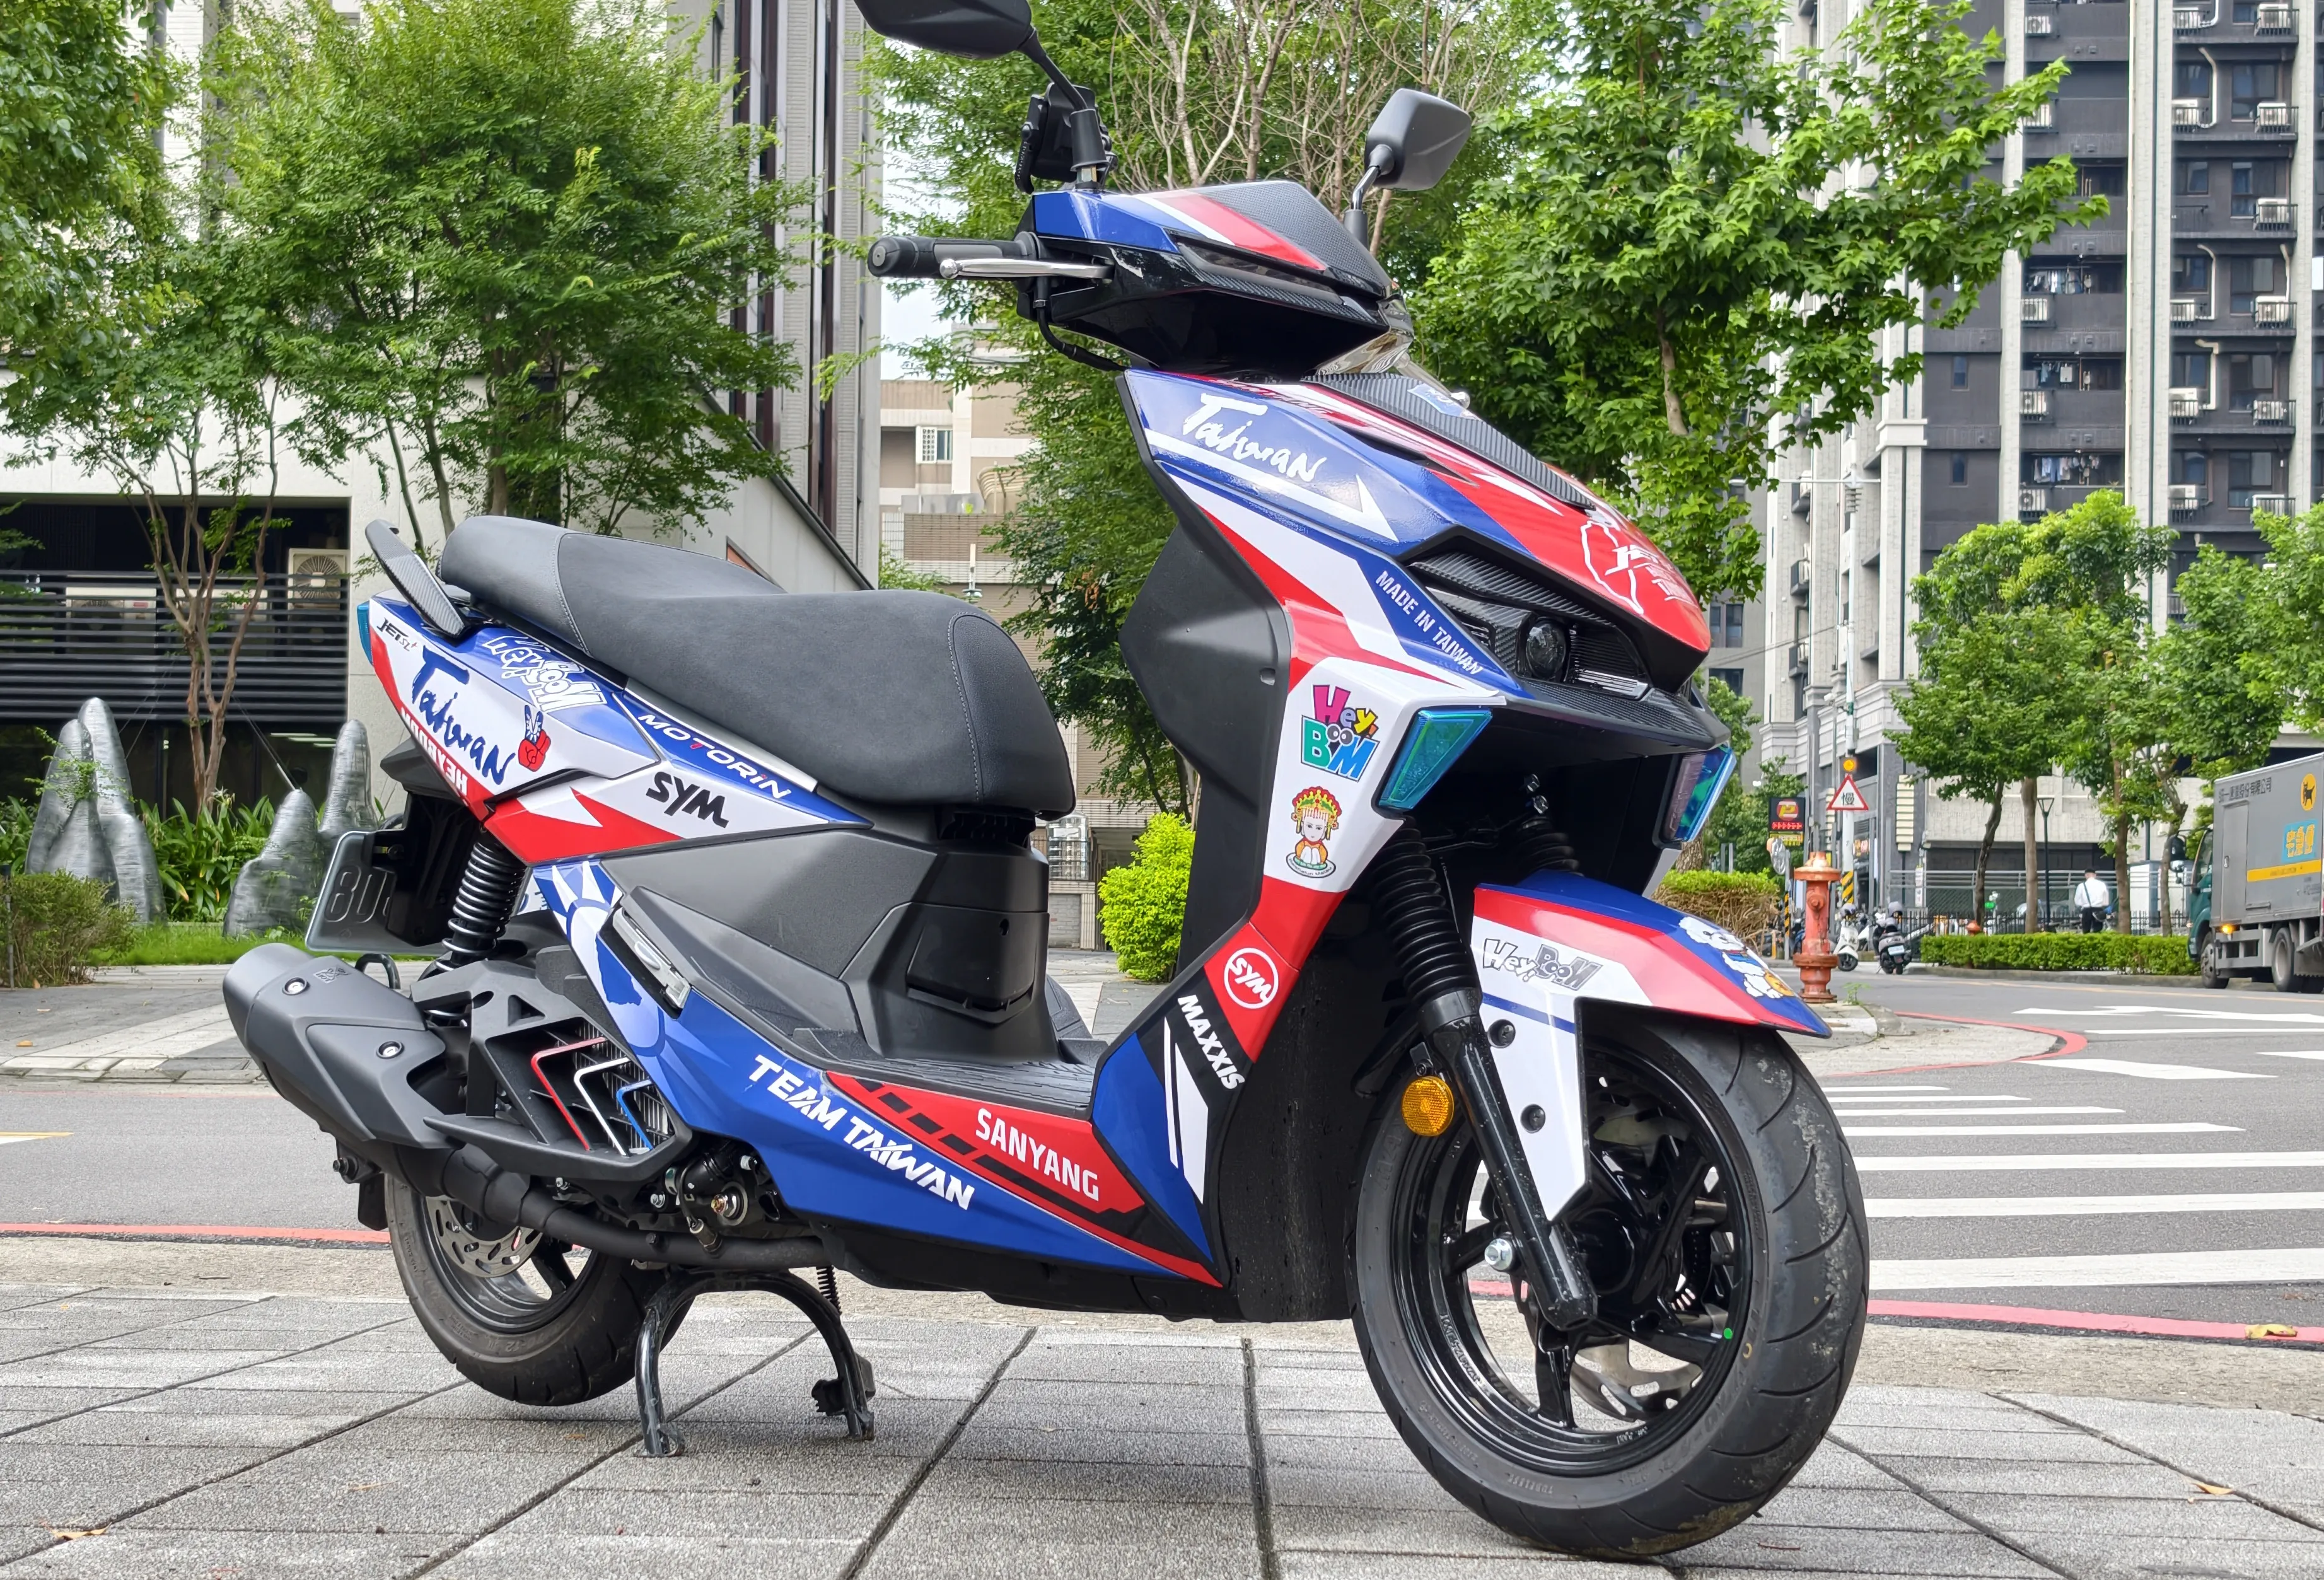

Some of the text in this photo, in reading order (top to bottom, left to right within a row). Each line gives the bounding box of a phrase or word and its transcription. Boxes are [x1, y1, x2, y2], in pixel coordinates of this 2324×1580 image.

[377, 618, 409, 642] JET
[1374, 570, 1484, 676] MADE IN TAIWAN
[645, 771, 729, 828] SYM
[1841, 793, 1855, 806] 慢
[1229, 957, 1272, 1003] SYM
[1177, 994, 1245, 1089] MAXXIS
[748, 1054, 975, 1211] TEAM TAIWAN
[975, 1108, 1100, 1202] SANYANG
